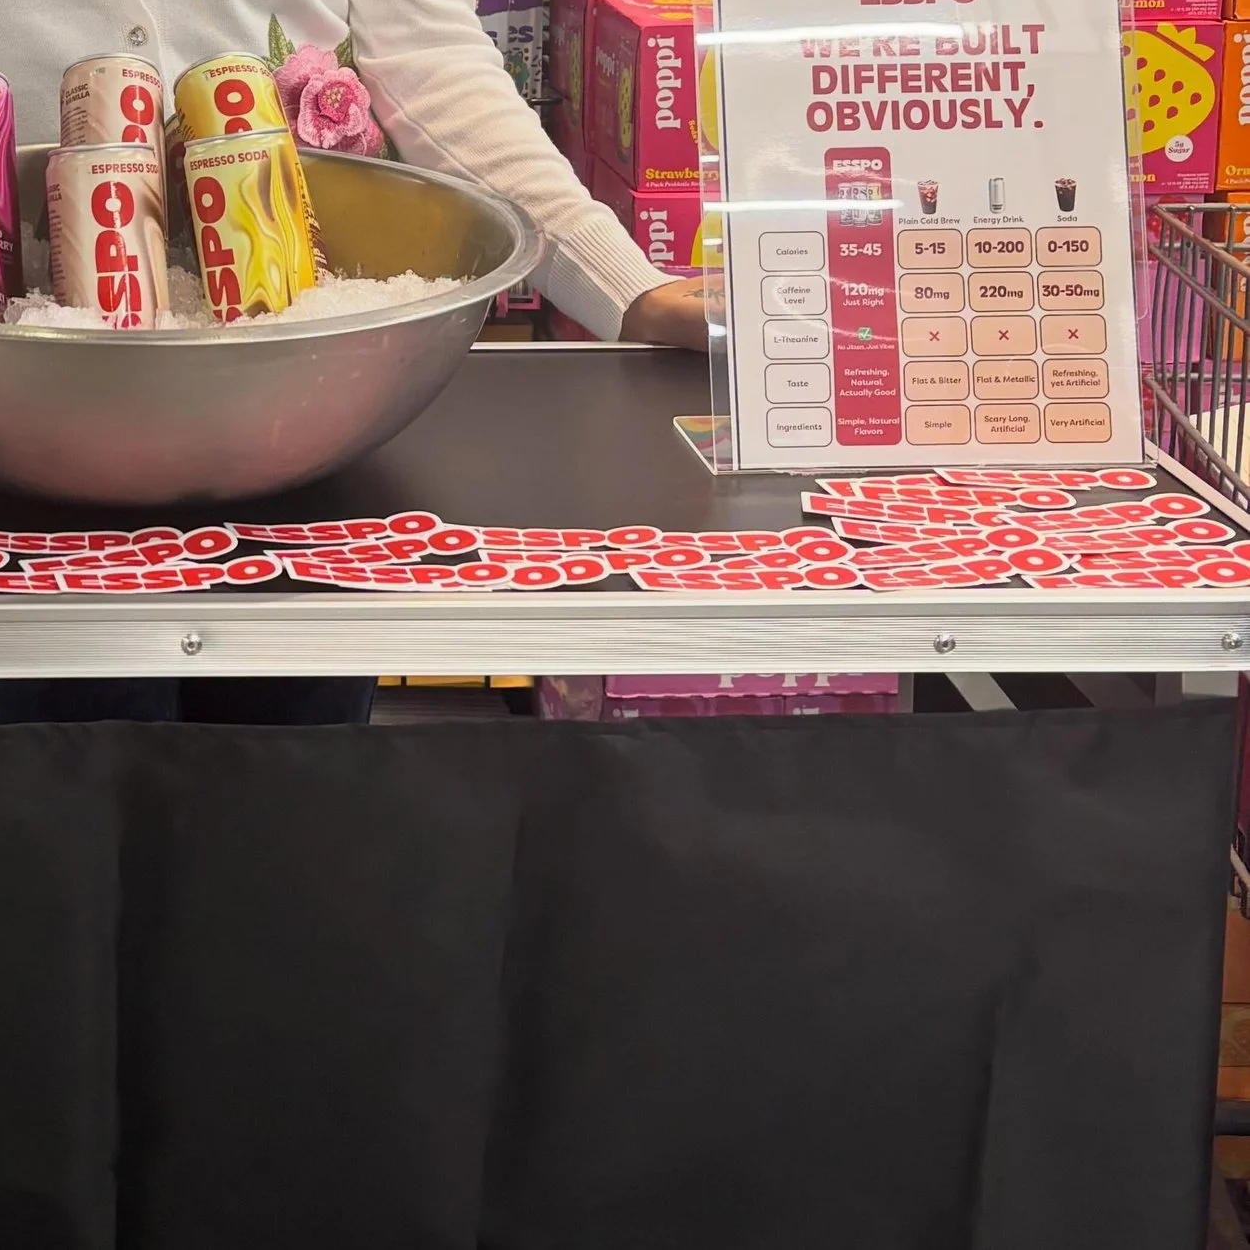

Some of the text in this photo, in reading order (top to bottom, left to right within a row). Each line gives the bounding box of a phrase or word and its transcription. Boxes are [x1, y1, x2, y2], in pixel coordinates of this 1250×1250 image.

[934, 23, 1045, 57] BUILT
[647, 36, 682, 130] poppi
[811, 61, 1036, 99] DIFFERENT,
[806, 97, 1044, 132] OBVIOUSLY.
[1168, 145, 1190, 154] Sugar
[189, 150, 269, 171] ESPRESSO SODA
[91, 163, 145, 175] ESPRESSO
[898, 216, 960, 225] Plain Cold Brew
[973, 215, 1024, 225] Energy Drink
[1057, 214, 1078, 222] Soda
[839, 243, 882, 257] 35-45
[914, 241, 946, 255] 5-15
[974, 240, 1025, 254] 10-200
[1047, 239, 1089, 253] 0-150
[775, 248, 808, 256] Calories
[777, 286, 811, 294] Caffeine
[841, 283, 885, 296] 120mg
[914, 286, 950, 300] 80mg
[979, 285, 1024, 299] 220mg
[1041, 284, 1100, 298] 30-50mg
[862, 298, 884, 307] Right
[774, 335, 819, 343] L-Theanine
[939, 376, 962, 384] Bitter
[1003, 375, 1036, 383] Metallic
[1051, 378, 1101, 388] yet Artificial
[839, 388, 896, 397] Actually Good
[869, 417, 900, 425] Natural
[984, 415, 1007, 425] Scary
[1050, 418, 1105, 428] Very Artificial
[776, 423, 823, 432] Ingredients
[924, 421, 952, 430] Simple
[991, 424, 1026, 433] Artificial
[854, 427, 884, 435] Flavors
[232, 514, 437, 542] ESSPO
[63, 558, 277, 591] ESSPO
[639, 567, 858, 590] ESSPO
